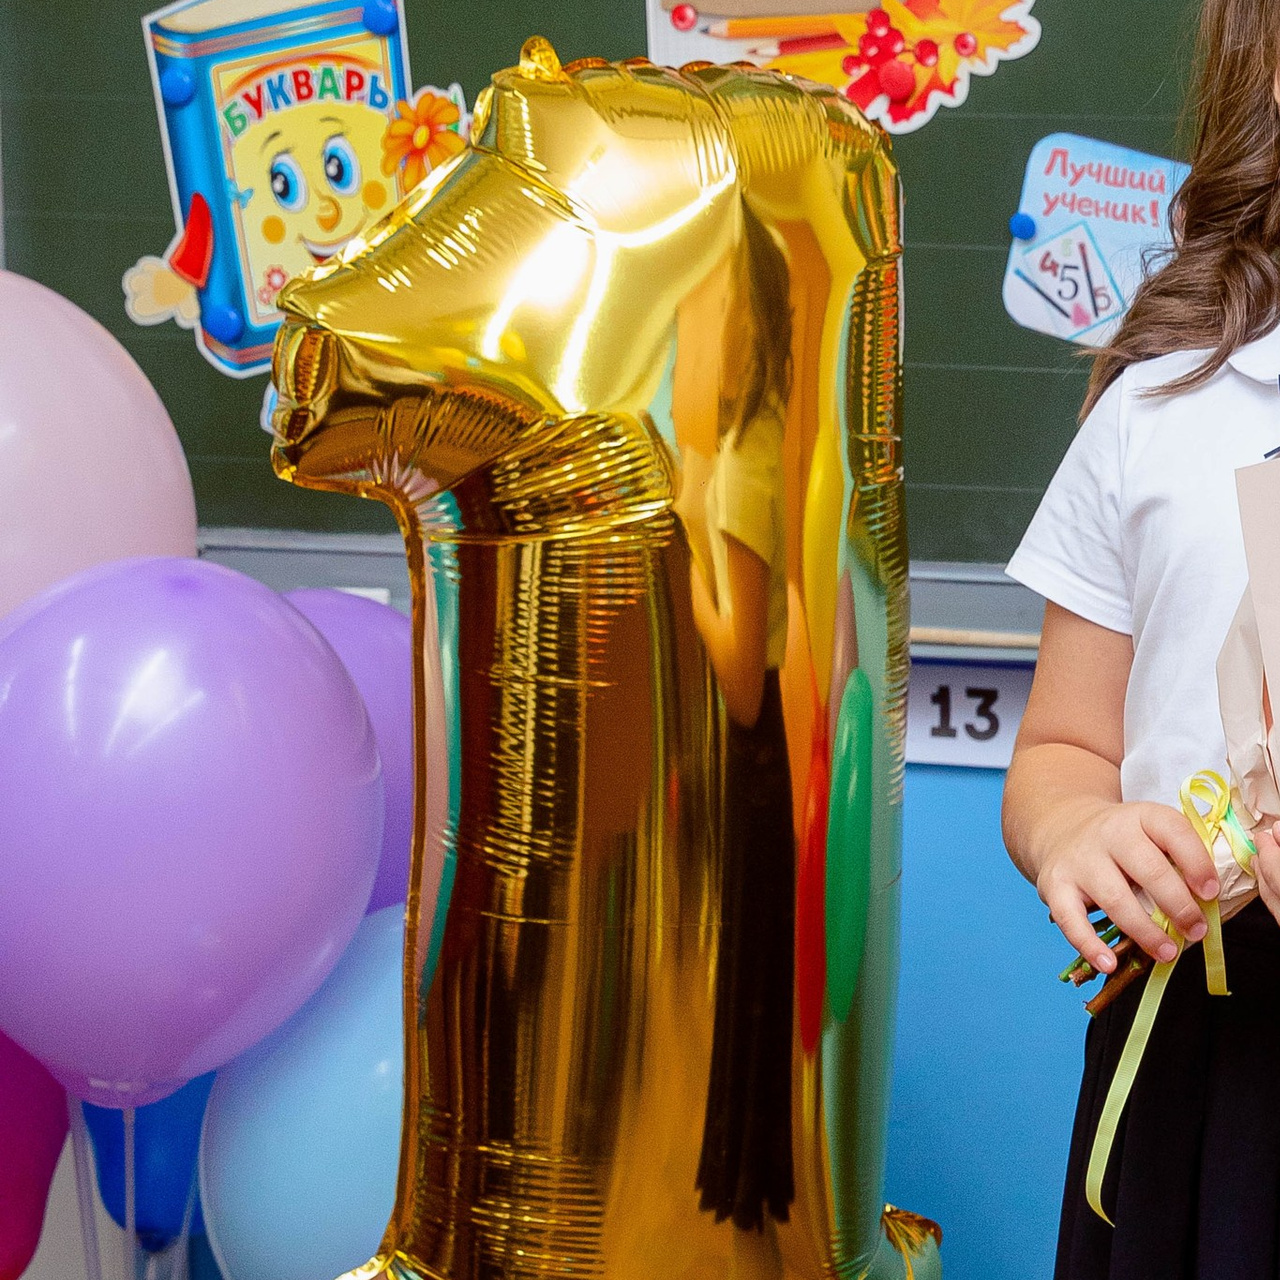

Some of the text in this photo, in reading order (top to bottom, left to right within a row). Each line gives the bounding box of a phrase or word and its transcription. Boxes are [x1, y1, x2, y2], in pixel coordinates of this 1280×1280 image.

[222, 66, 390, 138] БУКВАРЬ
[1044, 148, 1166, 195] Лучший
[1043, 192, 1160, 228] ученик!
[1058, 264, 1079, 301] 5
[930, 684, 1000, 741] 13
